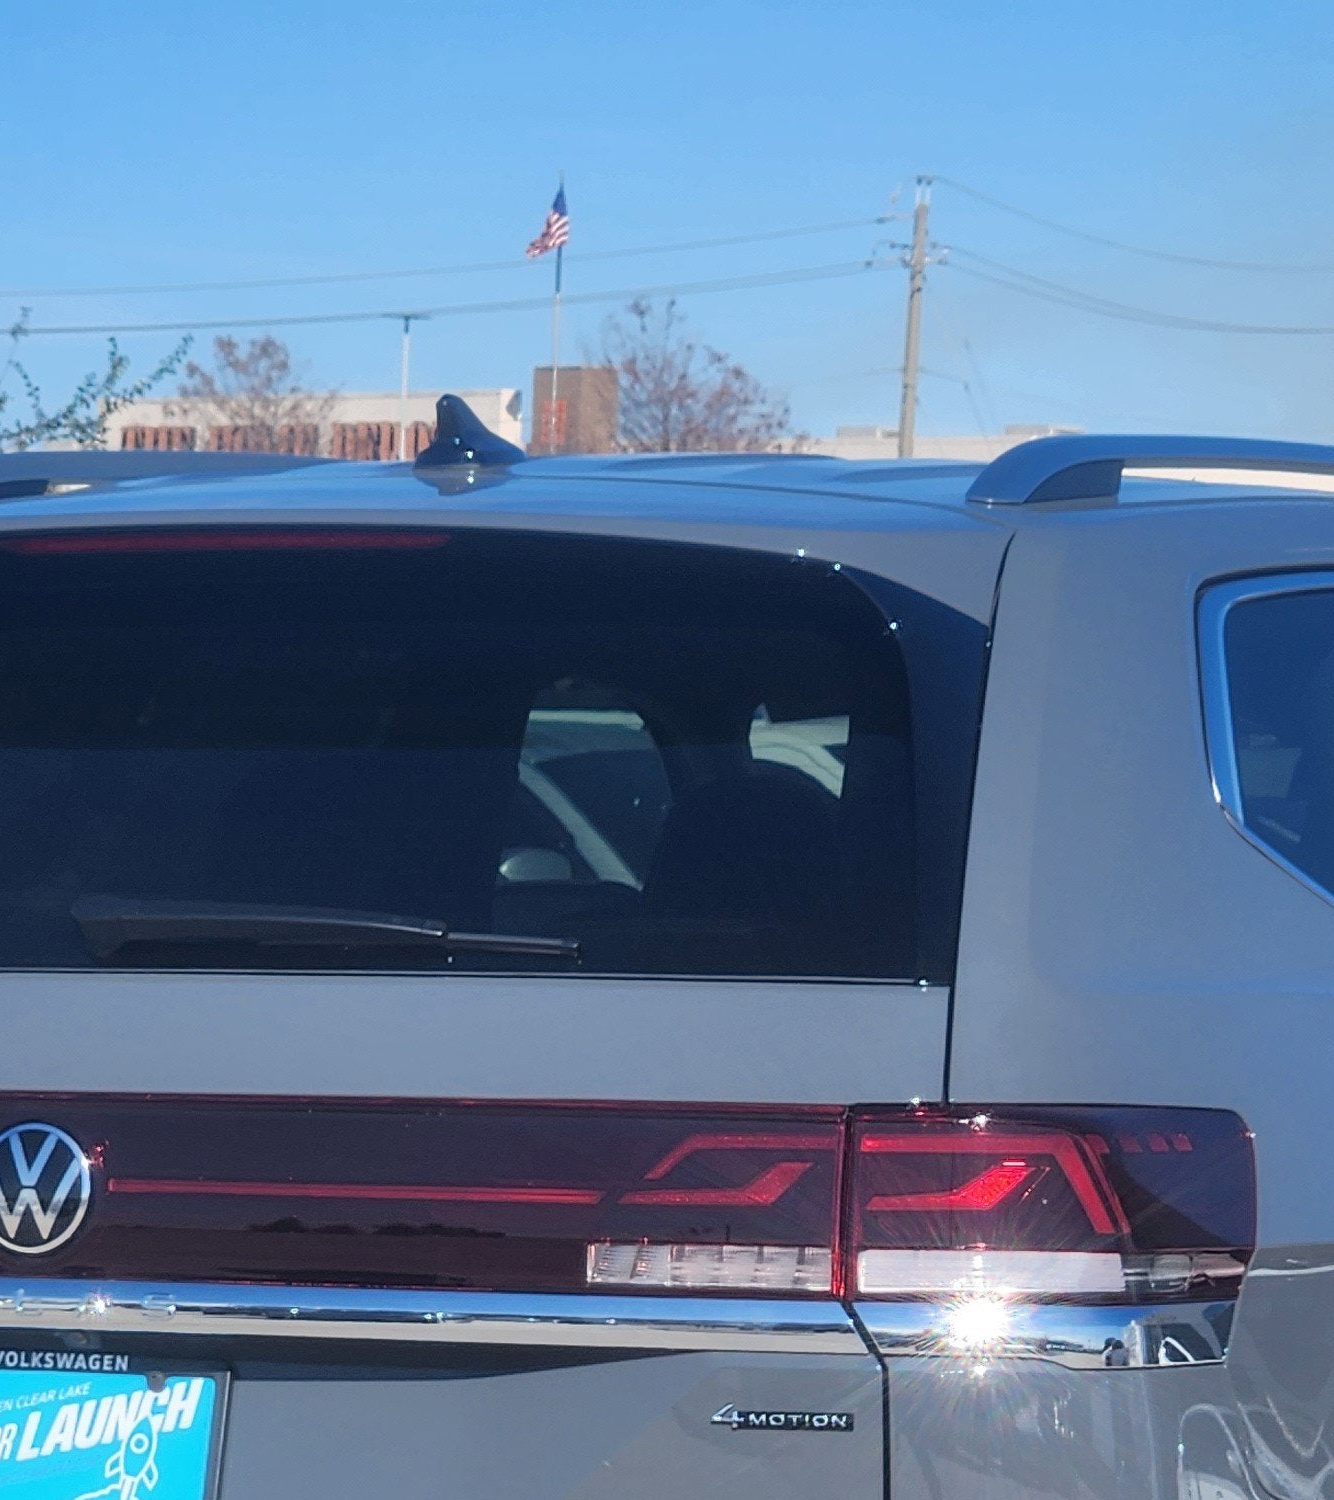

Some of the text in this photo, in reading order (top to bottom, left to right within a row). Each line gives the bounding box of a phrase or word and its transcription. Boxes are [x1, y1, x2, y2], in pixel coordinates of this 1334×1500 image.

[15, 1389, 57, 1409] CLEAR
[58, 1381, 92, 1400] LAKE
[15, 1377, 205, 1462] LAUNCH
[710, 1402, 849, 1430] 4MOTION
